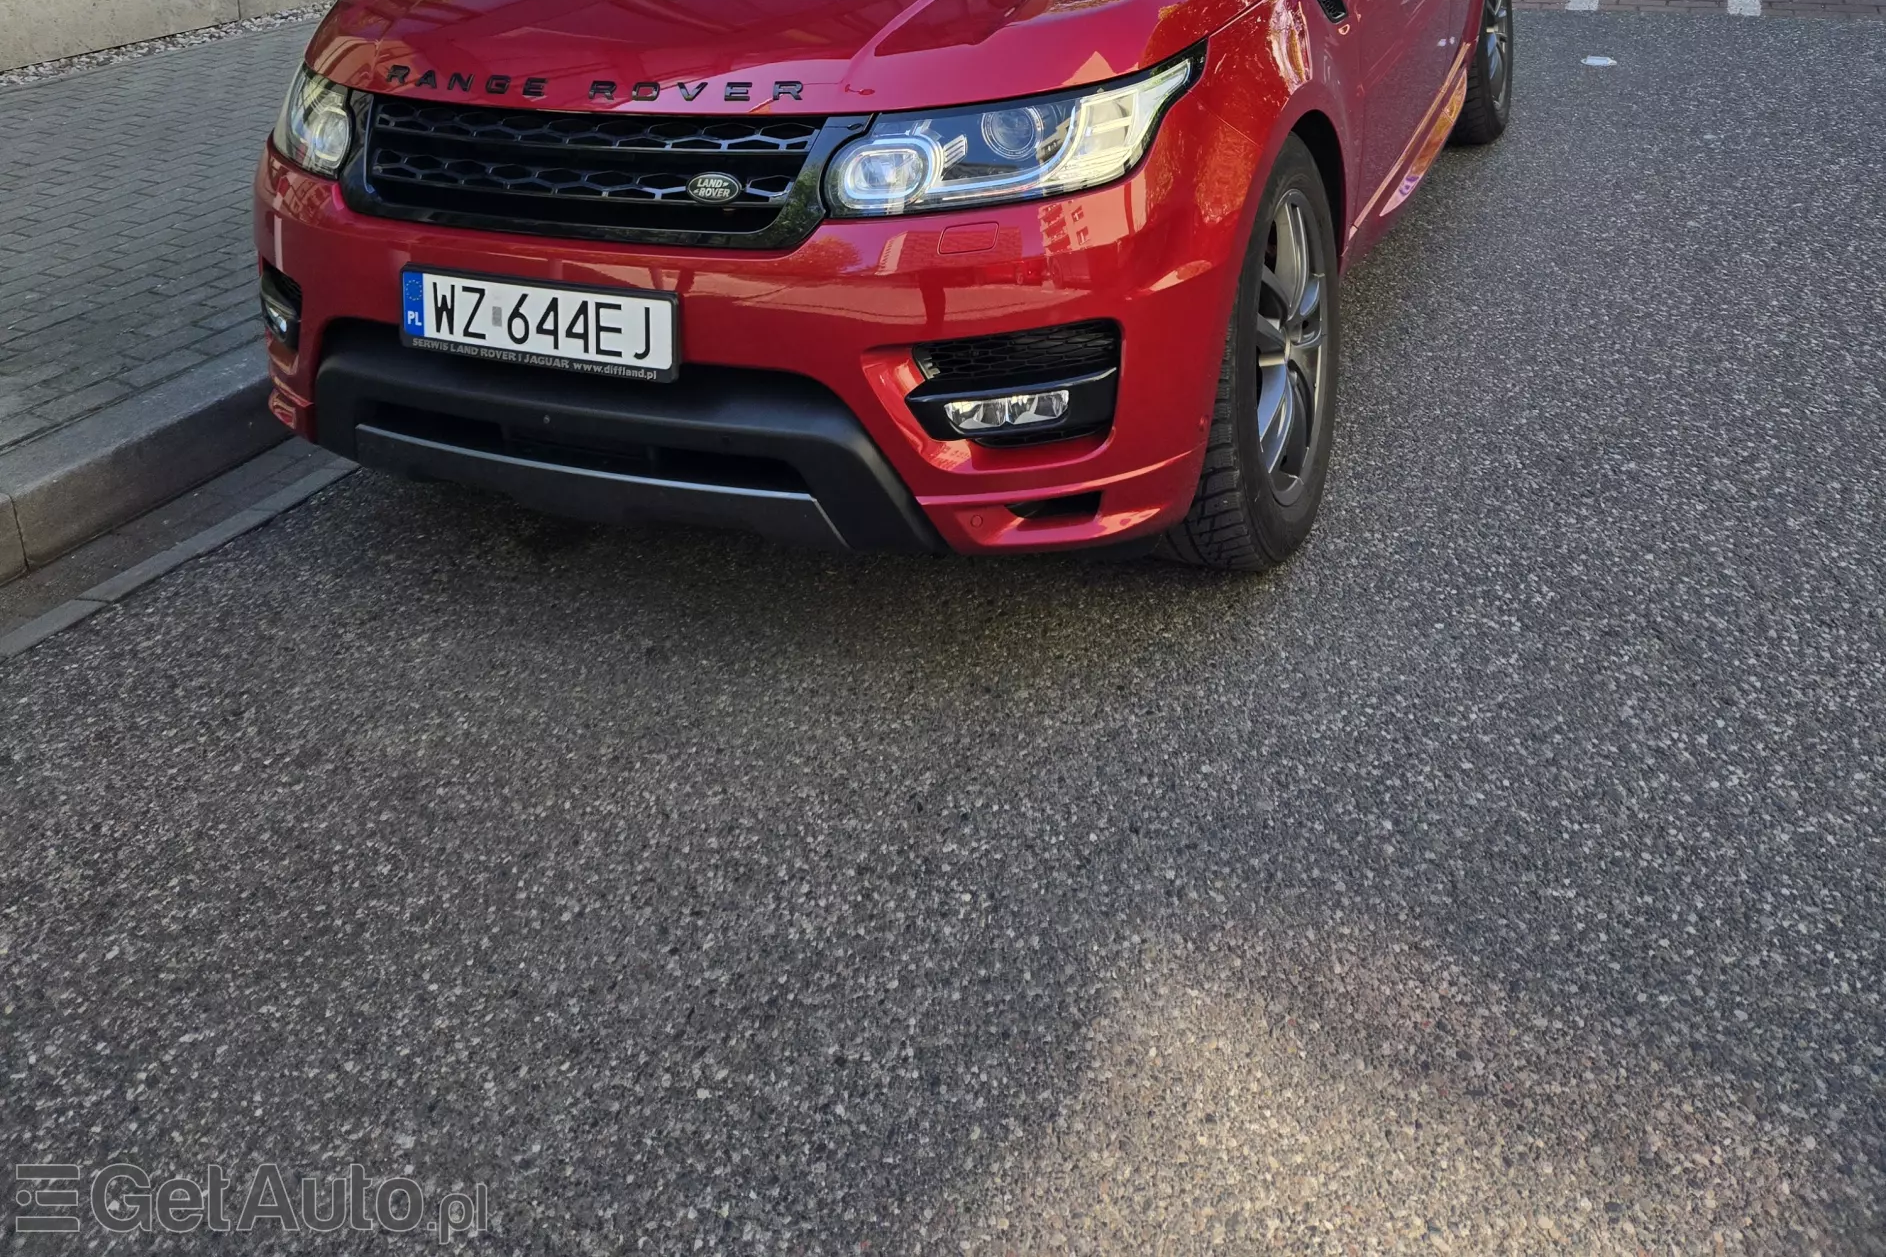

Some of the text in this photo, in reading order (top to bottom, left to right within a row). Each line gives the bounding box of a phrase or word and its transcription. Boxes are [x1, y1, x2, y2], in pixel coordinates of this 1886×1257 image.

[386, 65, 804, 102] RANGE ROVER
[697, 178, 723, 188] LAND
[698, 187, 731, 198] ROVER
[407, 310, 423, 326] PL
[432, 281, 651, 360] WZ 644EJ
[412, 337, 449, 351] SERWIS
[450, 343, 479, 356] LAND
[480, 348, 517, 361] ROVER
[523, 354, 570, 369] JAGUAR
[573, 362, 657, 380] www.diffland.pl
